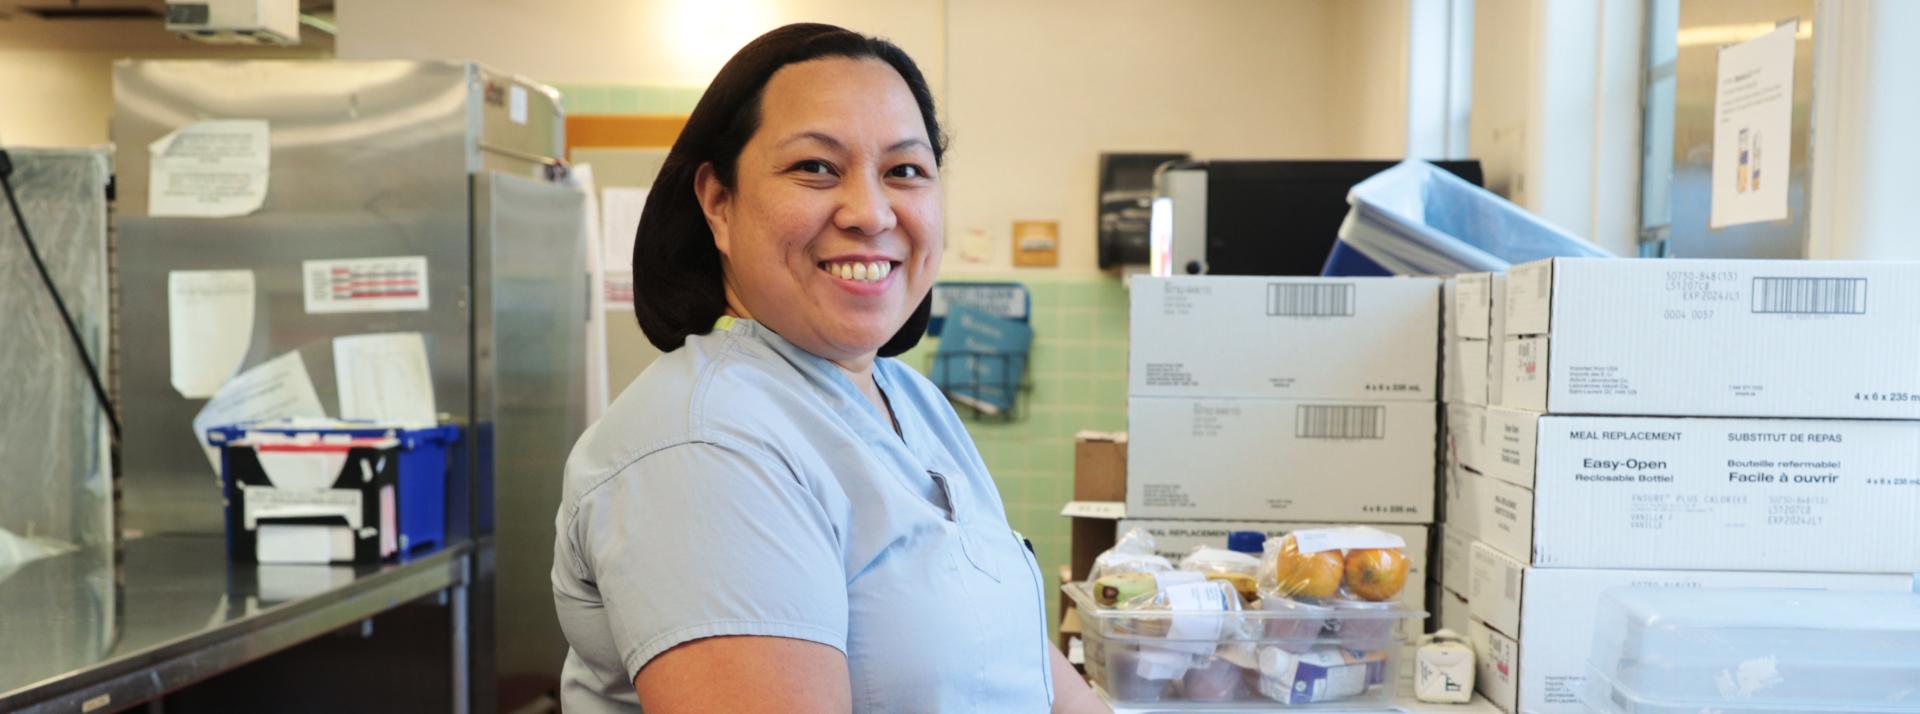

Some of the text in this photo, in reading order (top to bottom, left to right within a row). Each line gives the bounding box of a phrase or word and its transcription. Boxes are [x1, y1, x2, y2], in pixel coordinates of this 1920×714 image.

[1854, 392, 1860, 400] 4
[1872, 392, 1878, 401] 6
[1890, 393, 1909, 401] 235
[1570, 431, 1682, 441] MEAL REPLACEMENT
[1728, 433, 1842, 443] SUBSTITUT DE REPAS
[1583, 458, 1667, 471] Easy-Open
[1727, 460, 1841, 469] Bouteille refermable!
[1575, 474, 1674, 482] Reclosable Bottle!
[1729, 472, 1839, 483] Facile à ouvrir
